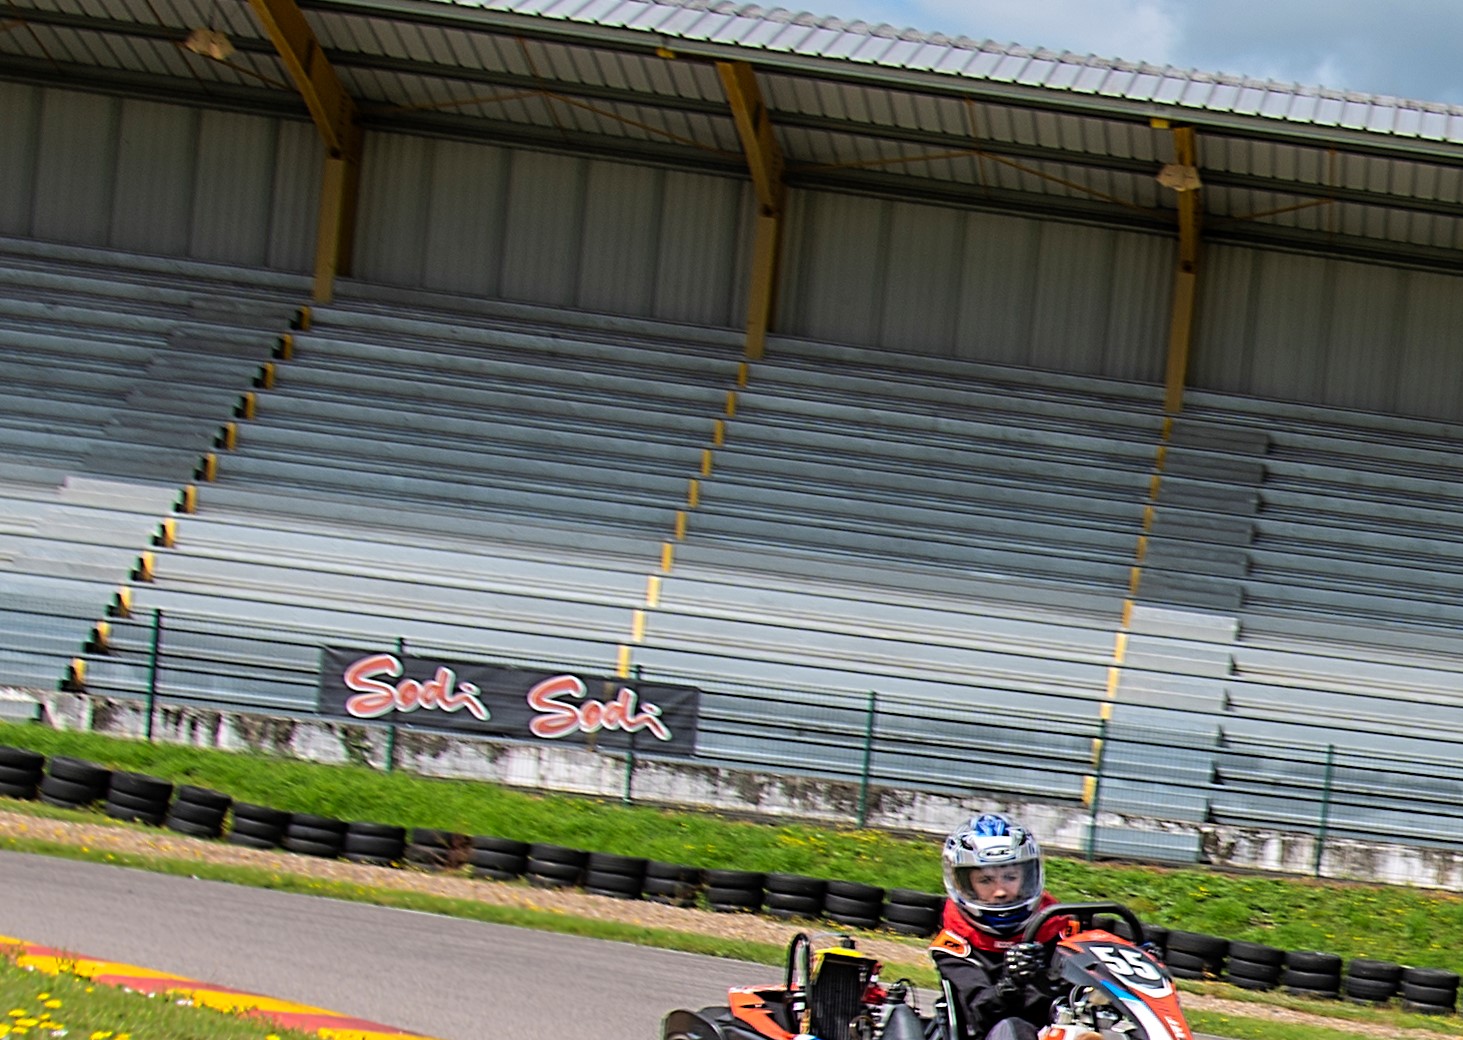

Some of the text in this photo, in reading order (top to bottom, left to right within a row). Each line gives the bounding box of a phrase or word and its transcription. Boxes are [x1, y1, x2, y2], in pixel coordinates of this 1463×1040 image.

[344, 653, 491, 721] Sodi
[527, 675, 673, 742] Sodi
[1088, 946, 1162, 980] 55
